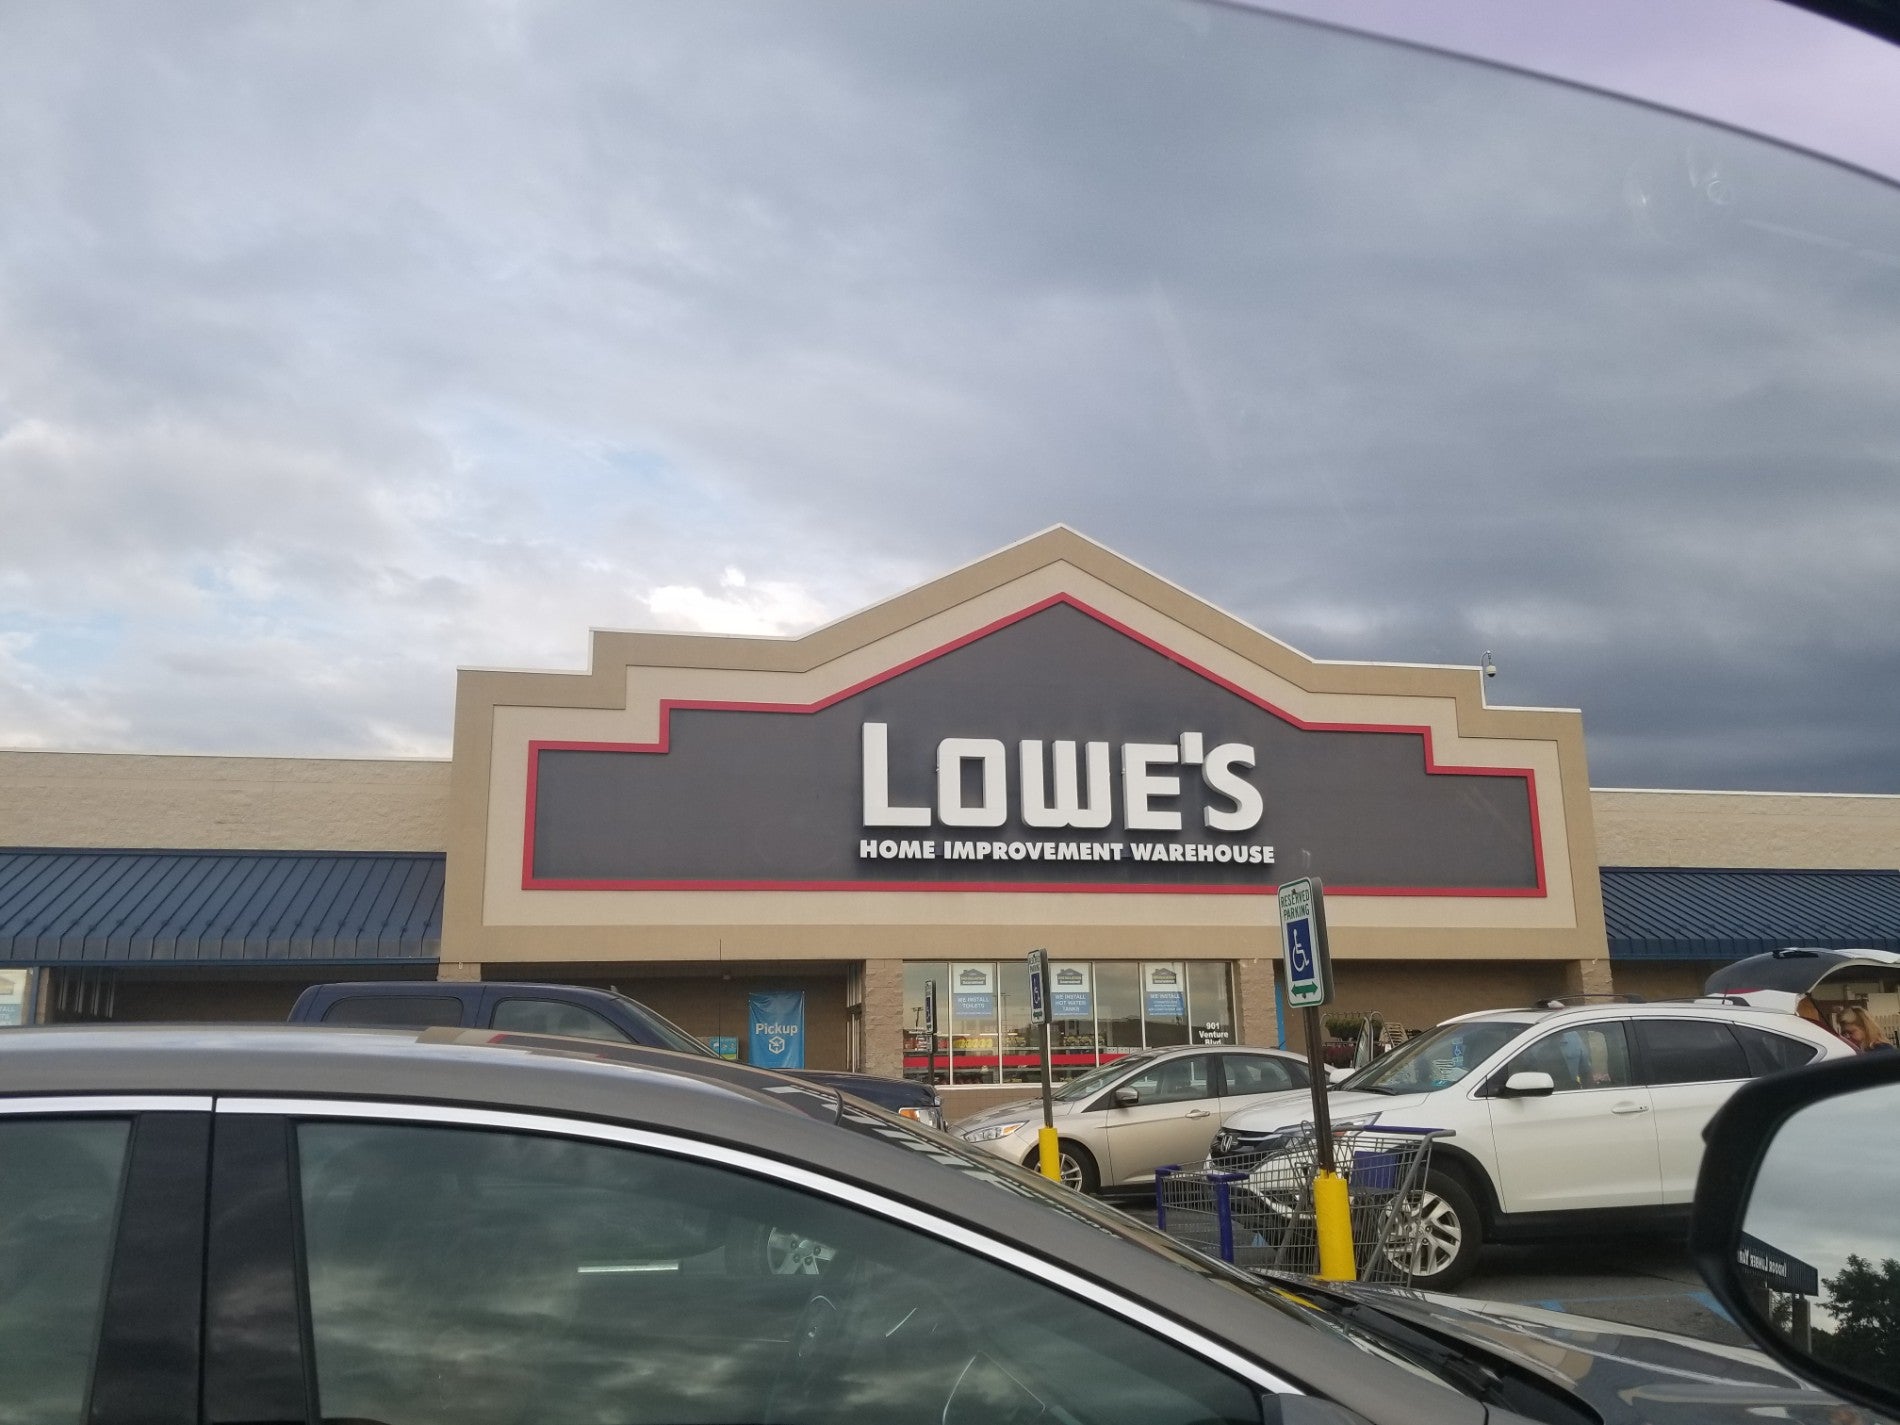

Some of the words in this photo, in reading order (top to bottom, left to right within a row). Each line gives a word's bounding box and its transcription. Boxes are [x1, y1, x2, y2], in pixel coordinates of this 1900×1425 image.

[862, 722, 1264, 831] LOWE'S
[859, 839, 936, 860] HOME
[943, 841, 1123, 862] IMPROVEMENT
[1130, 842, 1275, 864] WAREHOUSE
[1281, 890, 1310, 907] RESERVED
[1284, 904, 1310, 919] PARKING
[755, 1022, 798, 1036] Pickup
[1206, 1022, 1220, 1030] 901
[1198, 1031, 1229, 1039] Venture
